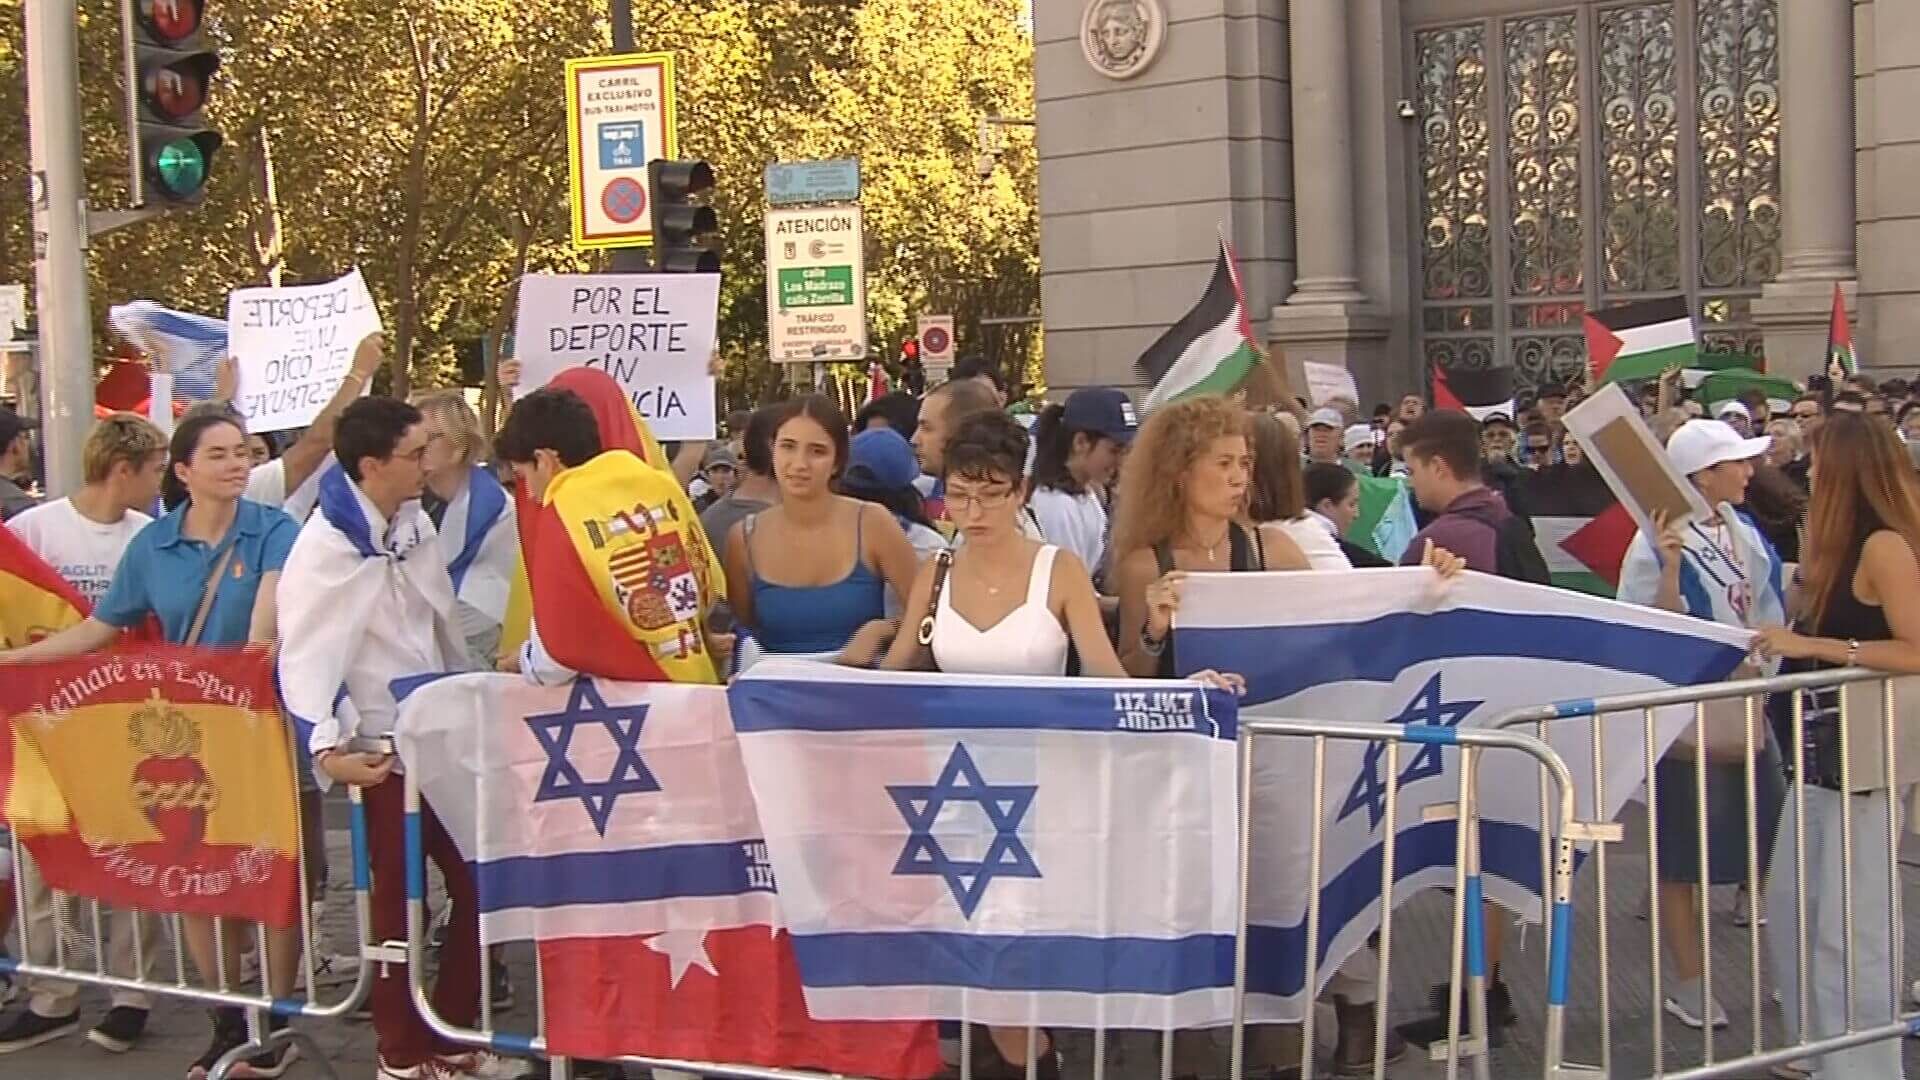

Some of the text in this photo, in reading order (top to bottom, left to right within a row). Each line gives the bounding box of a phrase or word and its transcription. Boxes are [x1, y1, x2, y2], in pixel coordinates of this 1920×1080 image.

[598, 77, 641, 88] CARRIL
[587, 88, 652, 101] EXCLUSIVO
[775, 217, 852, 235] ATENCIÓN
[571, 286, 671, 315] POR EL
[550, 322, 689, 352] DEPORTE
[787, 324, 847, 336] RESTRINGIDO
[132, 657, 163, 682] en
